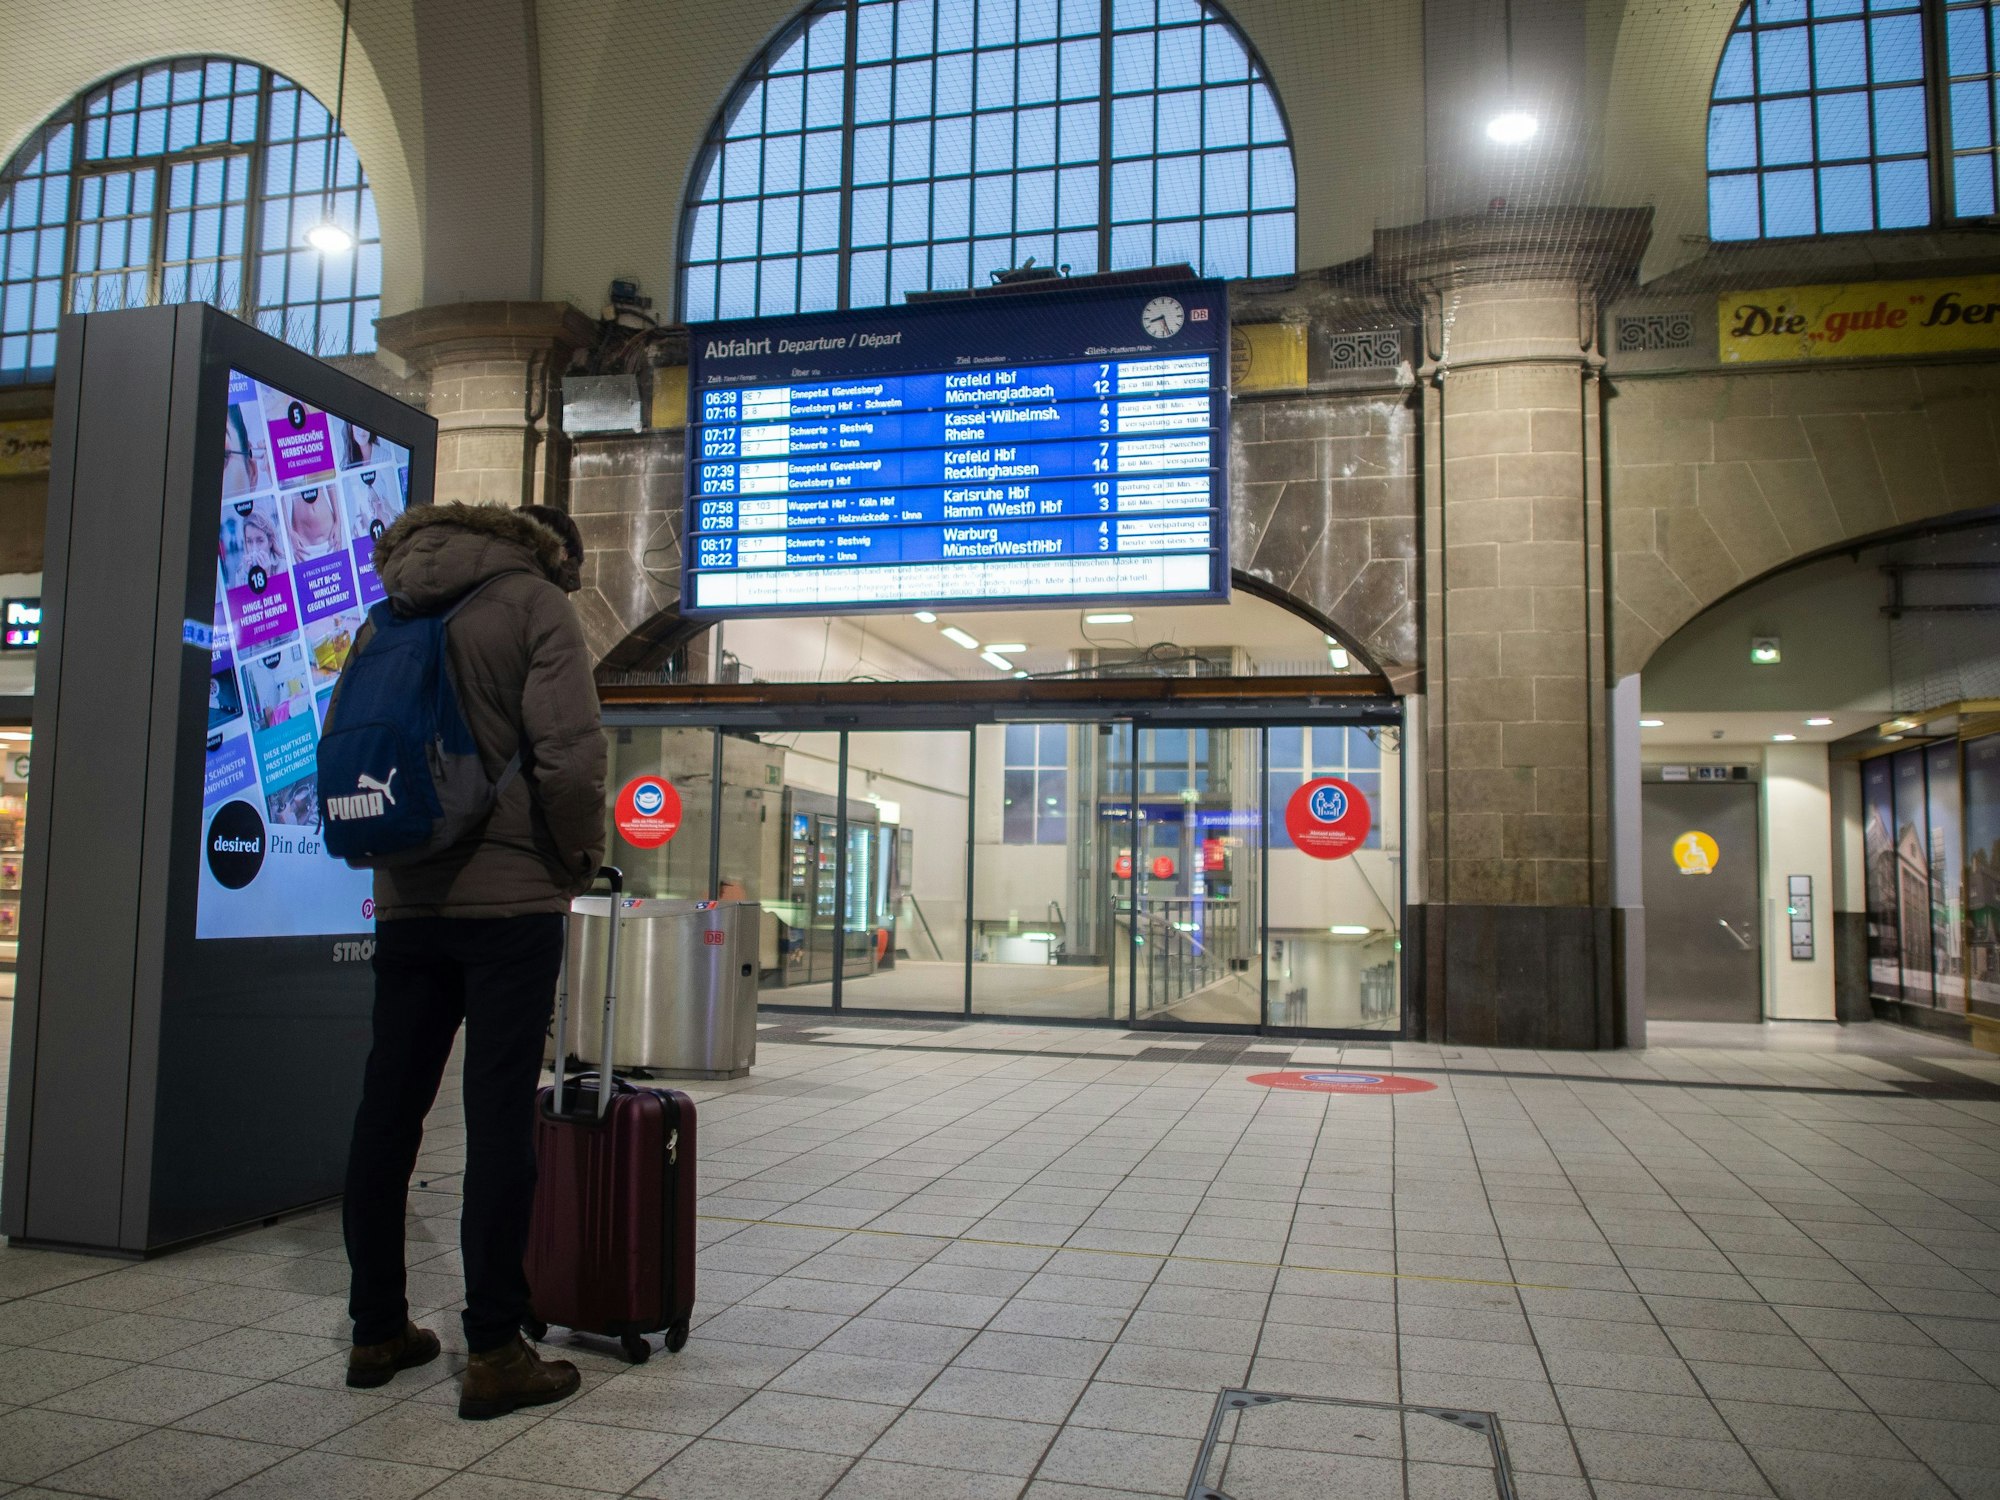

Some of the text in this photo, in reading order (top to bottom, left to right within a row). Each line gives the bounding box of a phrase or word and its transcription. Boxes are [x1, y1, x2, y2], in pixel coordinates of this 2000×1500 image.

[1191, 309, 1208, 321] DB
[1731, 303, 1806, 337] Die
[705, 331, 902, 359] Abfahrt Departure / Départ
[956, 355, 971, 365] Ziel
[1101, 364, 1110, 378] 7
[945, 371, 1017, 389] Krefeld Hbf
[1093, 380, 1110, 394] 12
[706, 392, 737, 405] 06:39
[743, 391, 763, 400] RE 7
[791, 384, 884, 402] Ennepetal (Gevelsberg)
[945, 384, 1054, 404] Mönchengladbach
[706, 406, 737, 420] 07:16
[791, 402, 836, 415] Gevelsberg
[838, 400, 853, 411] Hbf
[1099, 402, 1110, 416] 4
[293, 409, 301, 424] 5
[945, 407, 1061, 426] Kassel-Wilhelmsh.
[741, 428, 752, 437] RE
[790, 422, 874, 437] Schwerte Bestwig
[1100, 418, 1110, 433] 3
[277, 429, 324, 448] WUNDERSCHÖNE
[704, 427, 736, 441] 07:17
[945, 427, 985, 442] Rheine
[281, 441, 324, 460] HERBST-LOOKS
[704, 442, 736, 456] 07:22
[741, 443, 752, 452] RE
[790, 438, 860, 452] Schwerte Unna
[1100, 442, 1110, 456] 7
[944, 448, 1016, 465] Krefeld Hbf
[703, 465, 735, 479] 07:39
[789, 458, 882, 475] Ennepetal (Gevelsberg)
[944, 464, 1039, 481] Recklinghausen
[1092, 459, 1109, 472] 14
[703, 479, 735, 493] 07:45
[789, 475, 852, 490] Gevelsberg Hbf
[1092, 482, 1109, 496] 10
[944, 486, 1030, 503] Karlsruhe Hbf
[702, 501, 734, 515] 07:58
[788, 496, 895, 512] Wuppertal Hbf Köln Hbf
[944, 500, 1062, 518] Hamm (Westf) Hbf
[1099, 498, 1109, 512] 3
[702, 516, 734, 530] 07:58
[788, 510, 923, 526] Schwerte Holzwickede Unna
[373, 523, 383, 538] 11
[943, 527, 998, 543] Warburg
[1098, 521, 1109, 535] 4
[701, 538, 732, 552] 08:17
[787, 535, 871, 549] Schwerte Bestwig
[943, 539, 1062, 558] Münster(Westf)Hbf
[1099, 537, 1109, 551] 3
[701, 553, 732, 567] 08:22
[787, 551, 858, 563] Schwerte Unna
[251, 572, 266, 589] 18
[308, 571, 341, 590] HILFT BI-OIL
[313, 583, 341, 600] WIRKLICH
[242, 592, 282, 615] DINGE, DIE IM
[307, 590, 350, 613] GEGEN NARBEN?
[240, 602, 288, 627] HERBST NERVEN
[263, 747, 280, 761] DIESE
[280, 732, 312, 754] DUFTKERZE
[265, 743, 314, 772] PASST ZU DEINEM
[209, 756, 246, 781] SCHÖNSTEN
[327, 792, 385, 821] PUMA
[213, 836, 260, 853] desired
[270, 835, 321, 855] Pin der
[706, 932, 722, 944] DB
